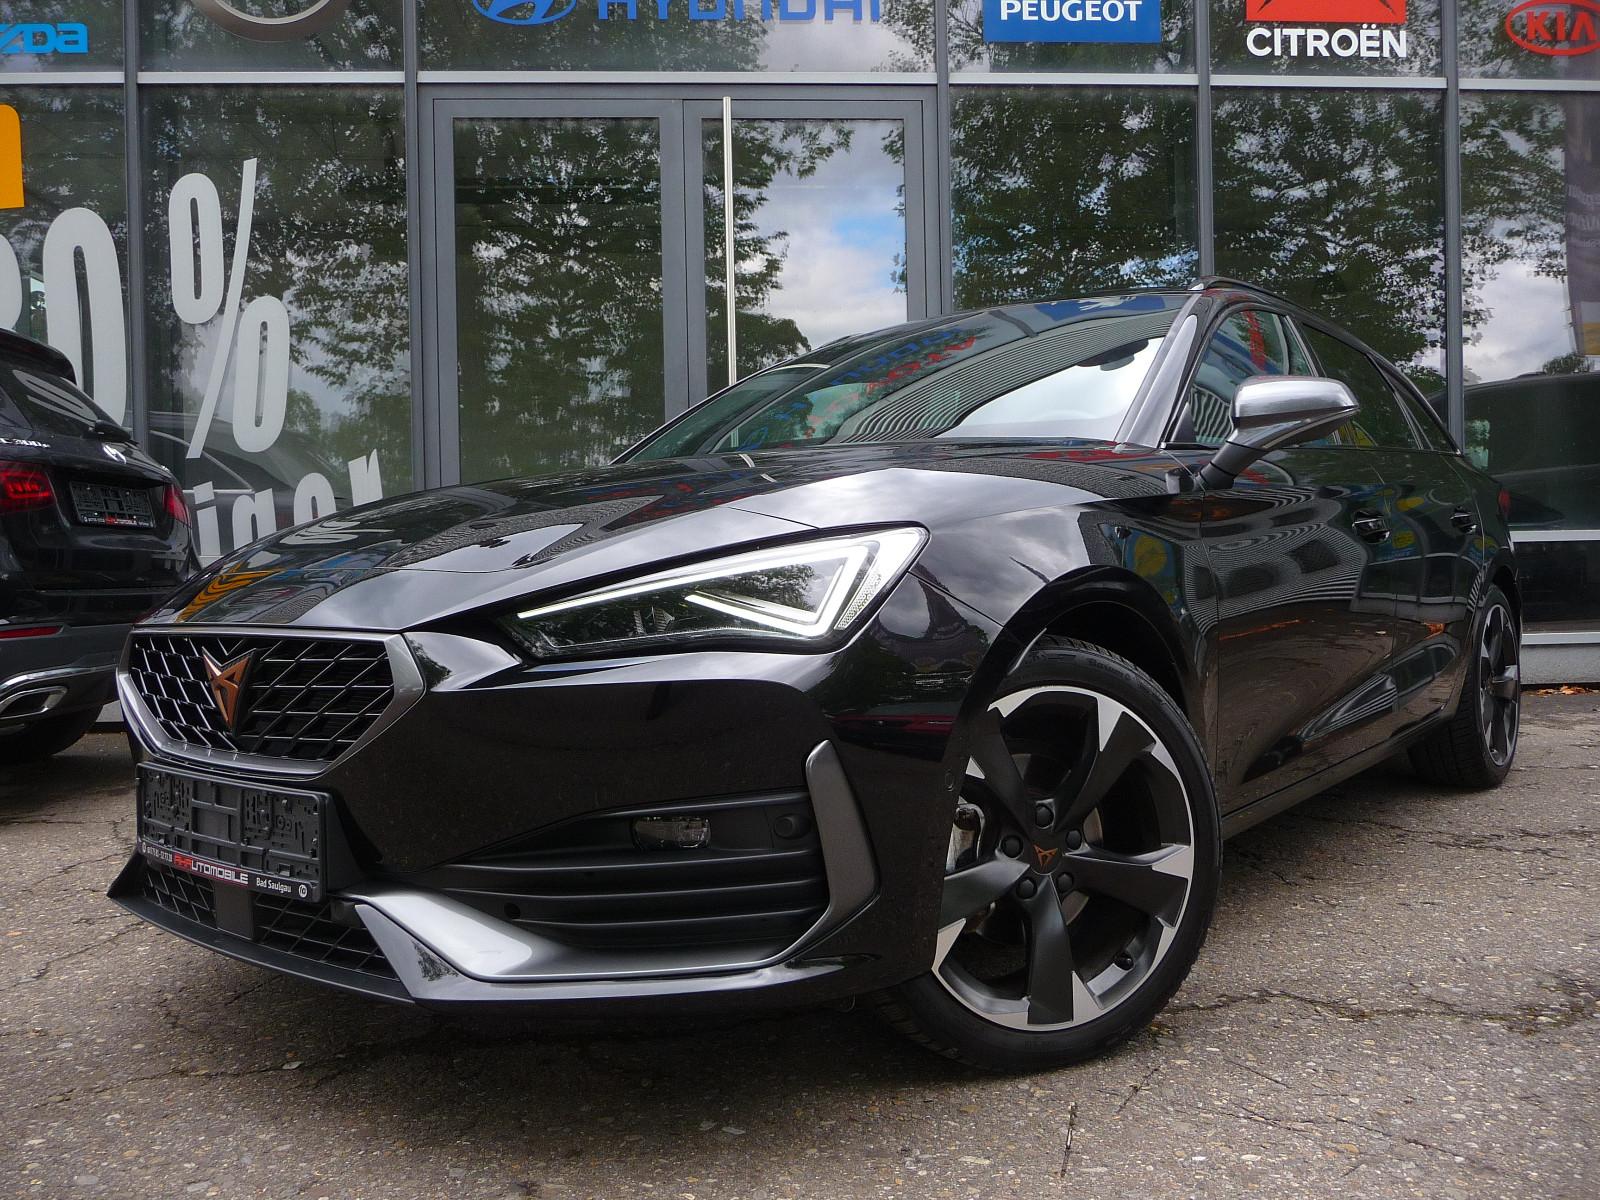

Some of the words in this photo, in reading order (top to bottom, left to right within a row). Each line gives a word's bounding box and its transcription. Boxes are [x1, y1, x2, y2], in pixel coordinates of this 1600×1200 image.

[1000, 0, 1142, 22] PEUGEOT
[1526, 10, 1597, 41] KIA
[1246, 23, 1407, 58] CITROËN
[256, 877, 267, 887] Bad
[268, 880, 292, 893] Saulgau
